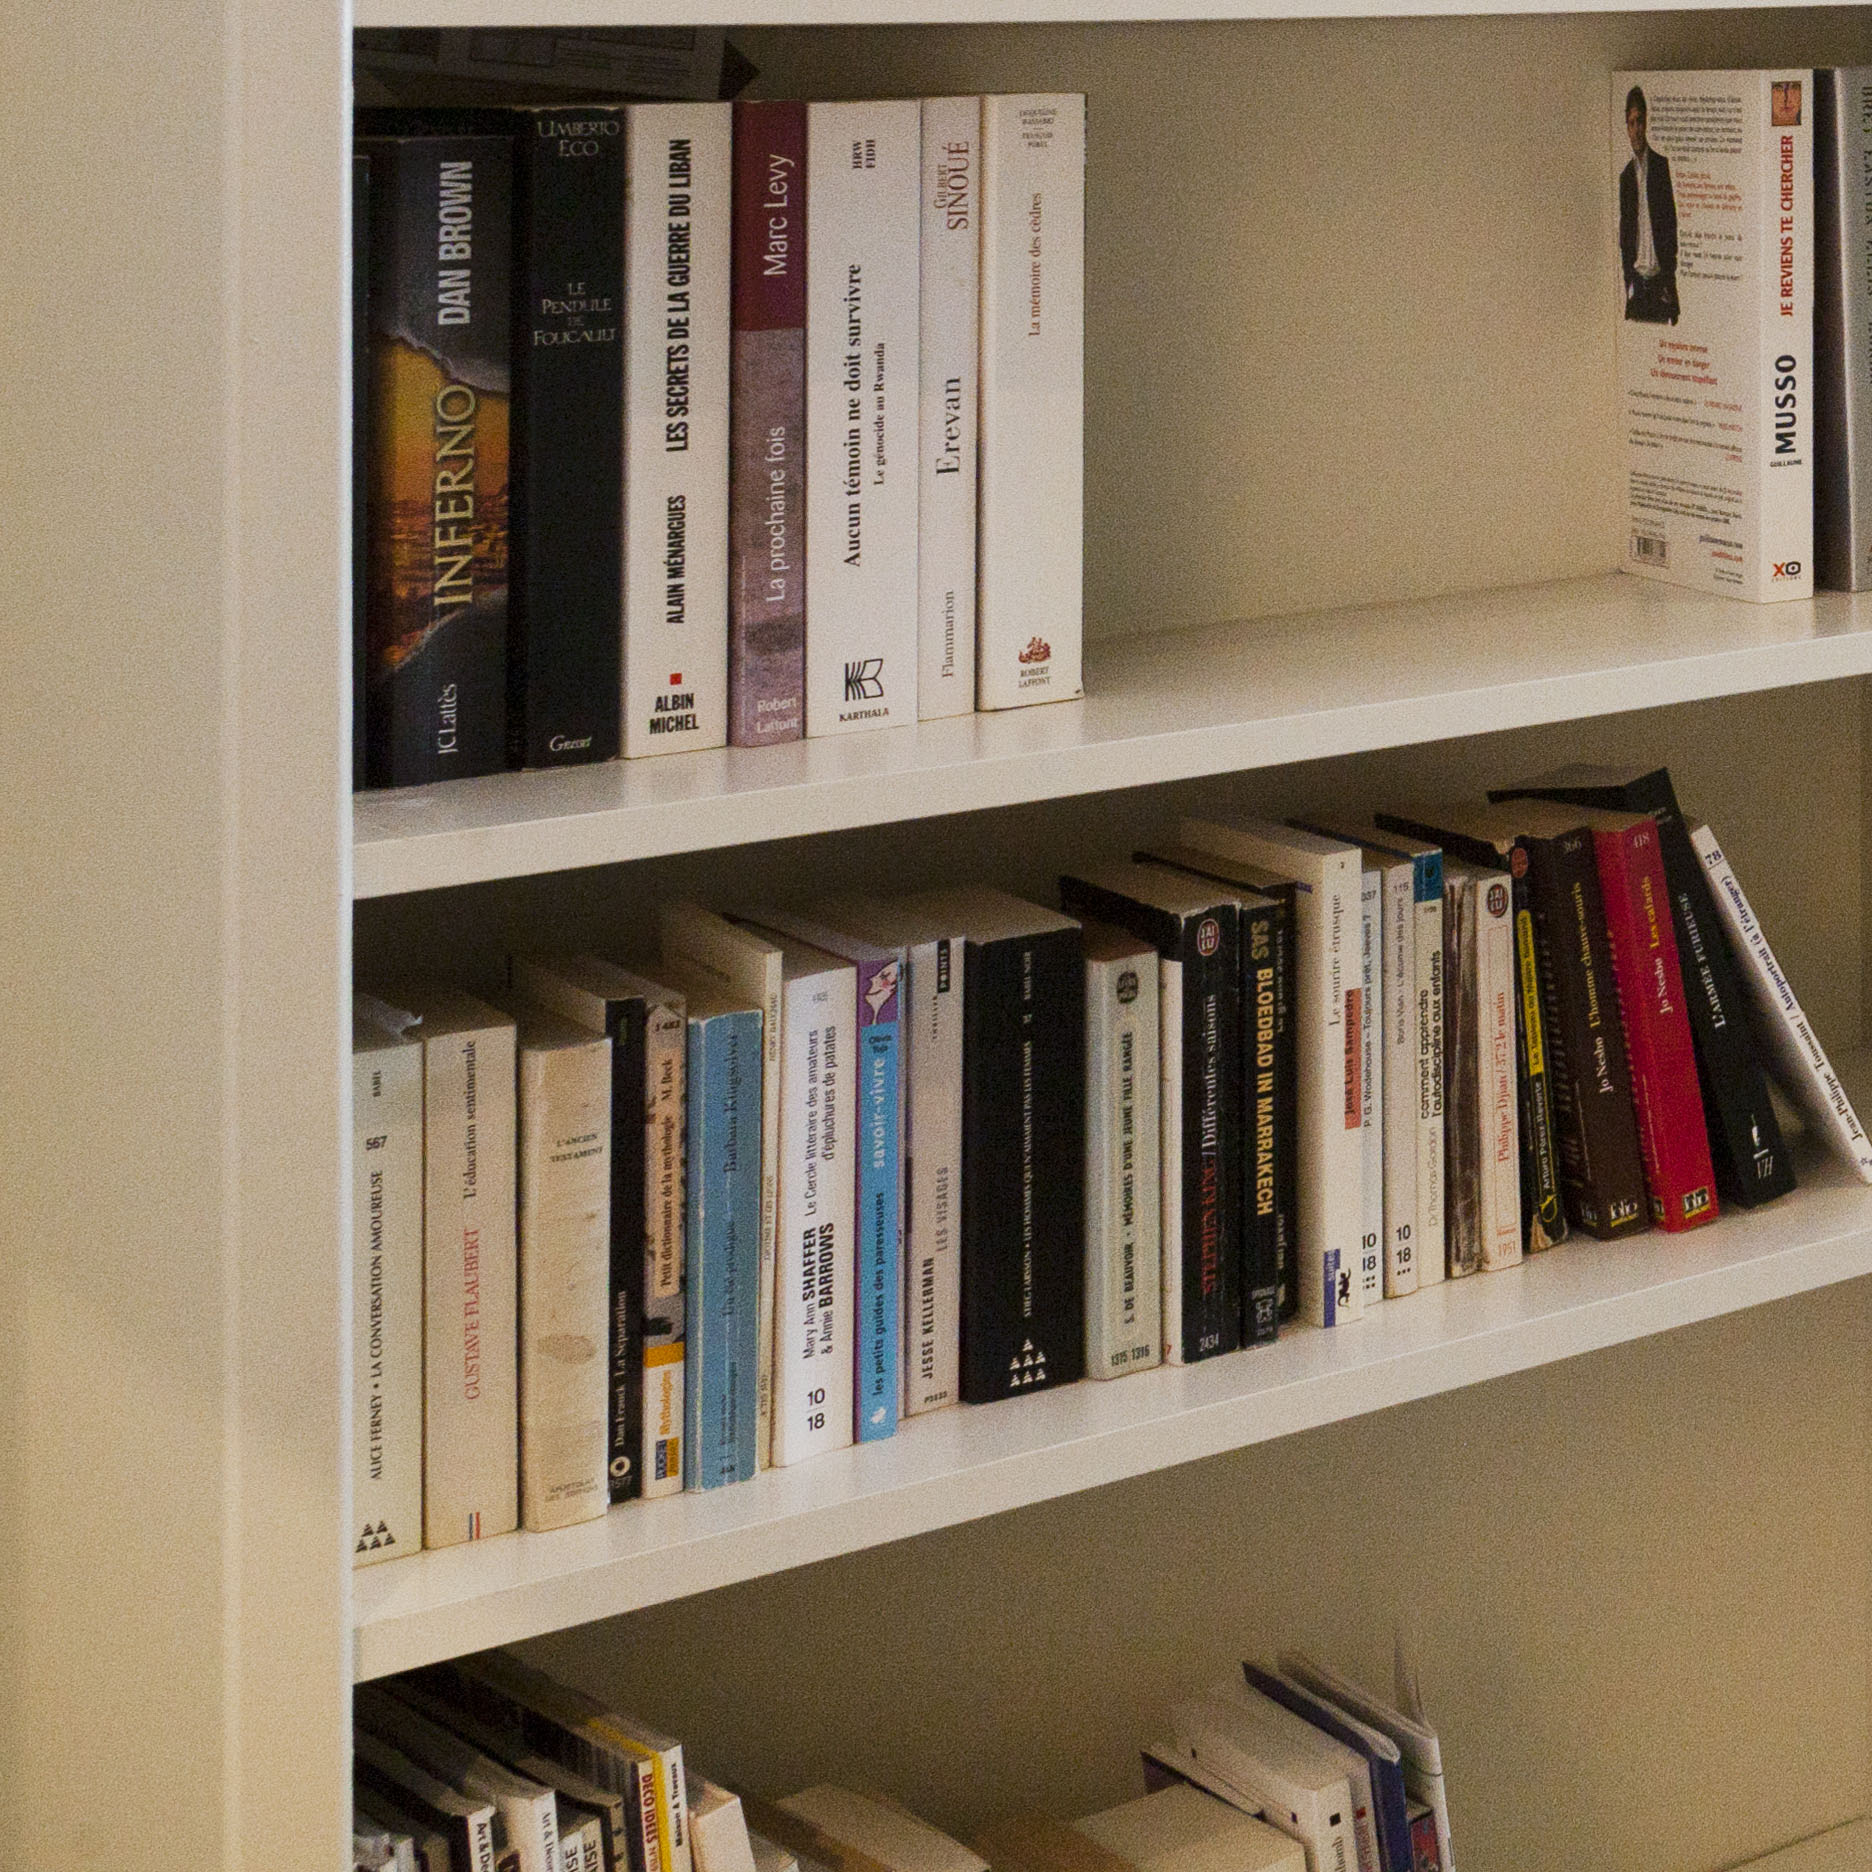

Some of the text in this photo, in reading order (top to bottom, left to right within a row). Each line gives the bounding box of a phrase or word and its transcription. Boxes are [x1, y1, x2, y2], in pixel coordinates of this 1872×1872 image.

[438, 160, 474, 325] DAN BROWN
[763, 152, 796, 277] Marc Levy
[941, 140, 970, 232] SINOUÉ
[1780, 135, 1794, 316] JE REVIENS TE CHERCHER
[665, 138, 692, 453] LES SECRETS DE LA GUERRE DU LIBAN
[843, 264, 863, 568] Aucun témoin ne doit survivre
[935, 376, 962, 476] Erevan
[1774, 354, 1797, 454] MUSSO
[431, 383, 477, 605] INFERNO
[765, 425, 790, 603] La prochaine fois
[660, 495, 686, 624] ALAIN MÉNARGUES
[940, 590, 955, 678] Flammarion
[649, 712, 699, 735] MICHEL
[654, 693, 695, 713] ALBIN
[838, 707, 890, 724] KARTHALA
[461, 1041, 478, 1199] L'éducation sentimentale
[872, 1058, 886, 1168] savoir-vivre
[1256, 967, 1273, 1216] BLOEDBAD IN MARRAKECH
[1795, 1021, 1864, 1142] Jean-Philippe Toussaint
[463, 1228, 481, 1400] GUSTAVE FLAUBERT
[921, 1257, 935, 1379] JESSE KELLERMAN
[369, 1394, 384, 1480] ALICE FERNEY
